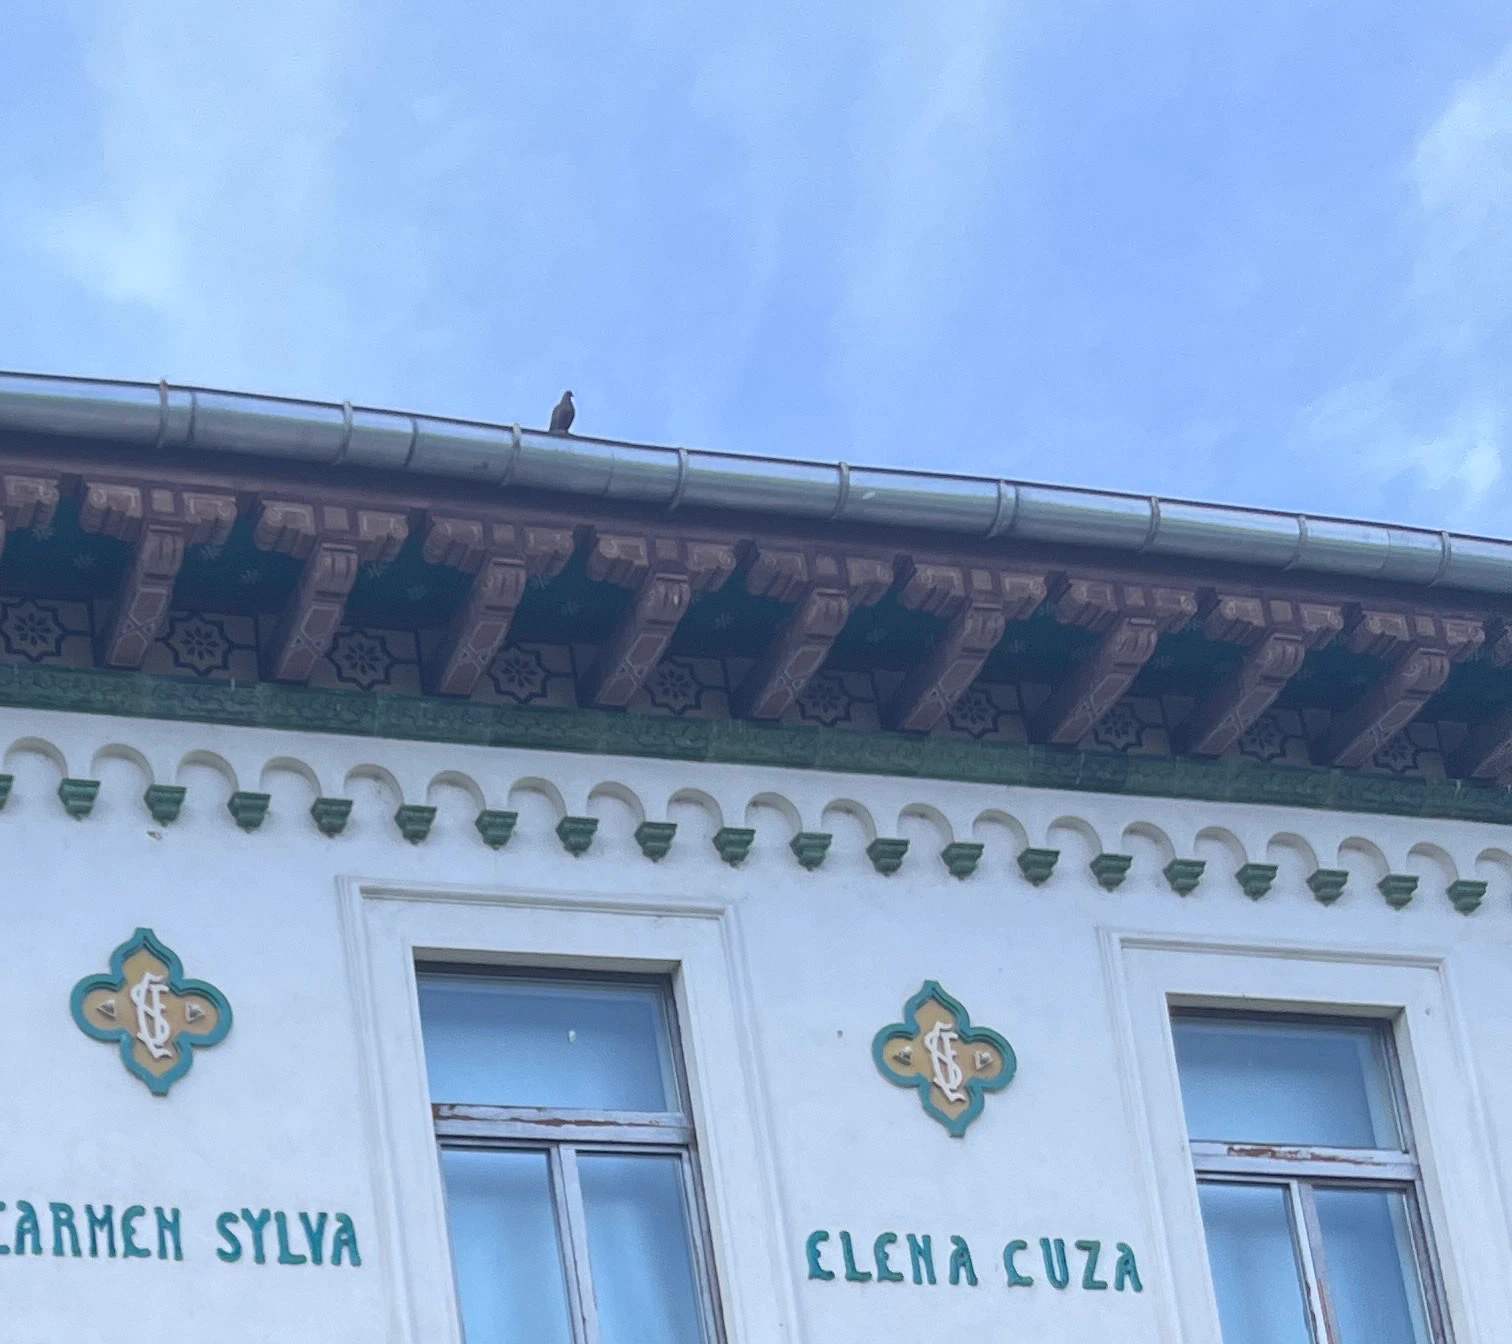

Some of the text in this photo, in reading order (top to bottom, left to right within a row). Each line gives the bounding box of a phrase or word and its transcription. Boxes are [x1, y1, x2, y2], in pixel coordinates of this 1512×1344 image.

[215, 1208, 362, 1267] SYLVA
[805, 1230, 1144, 1293] ELENA CUZA
